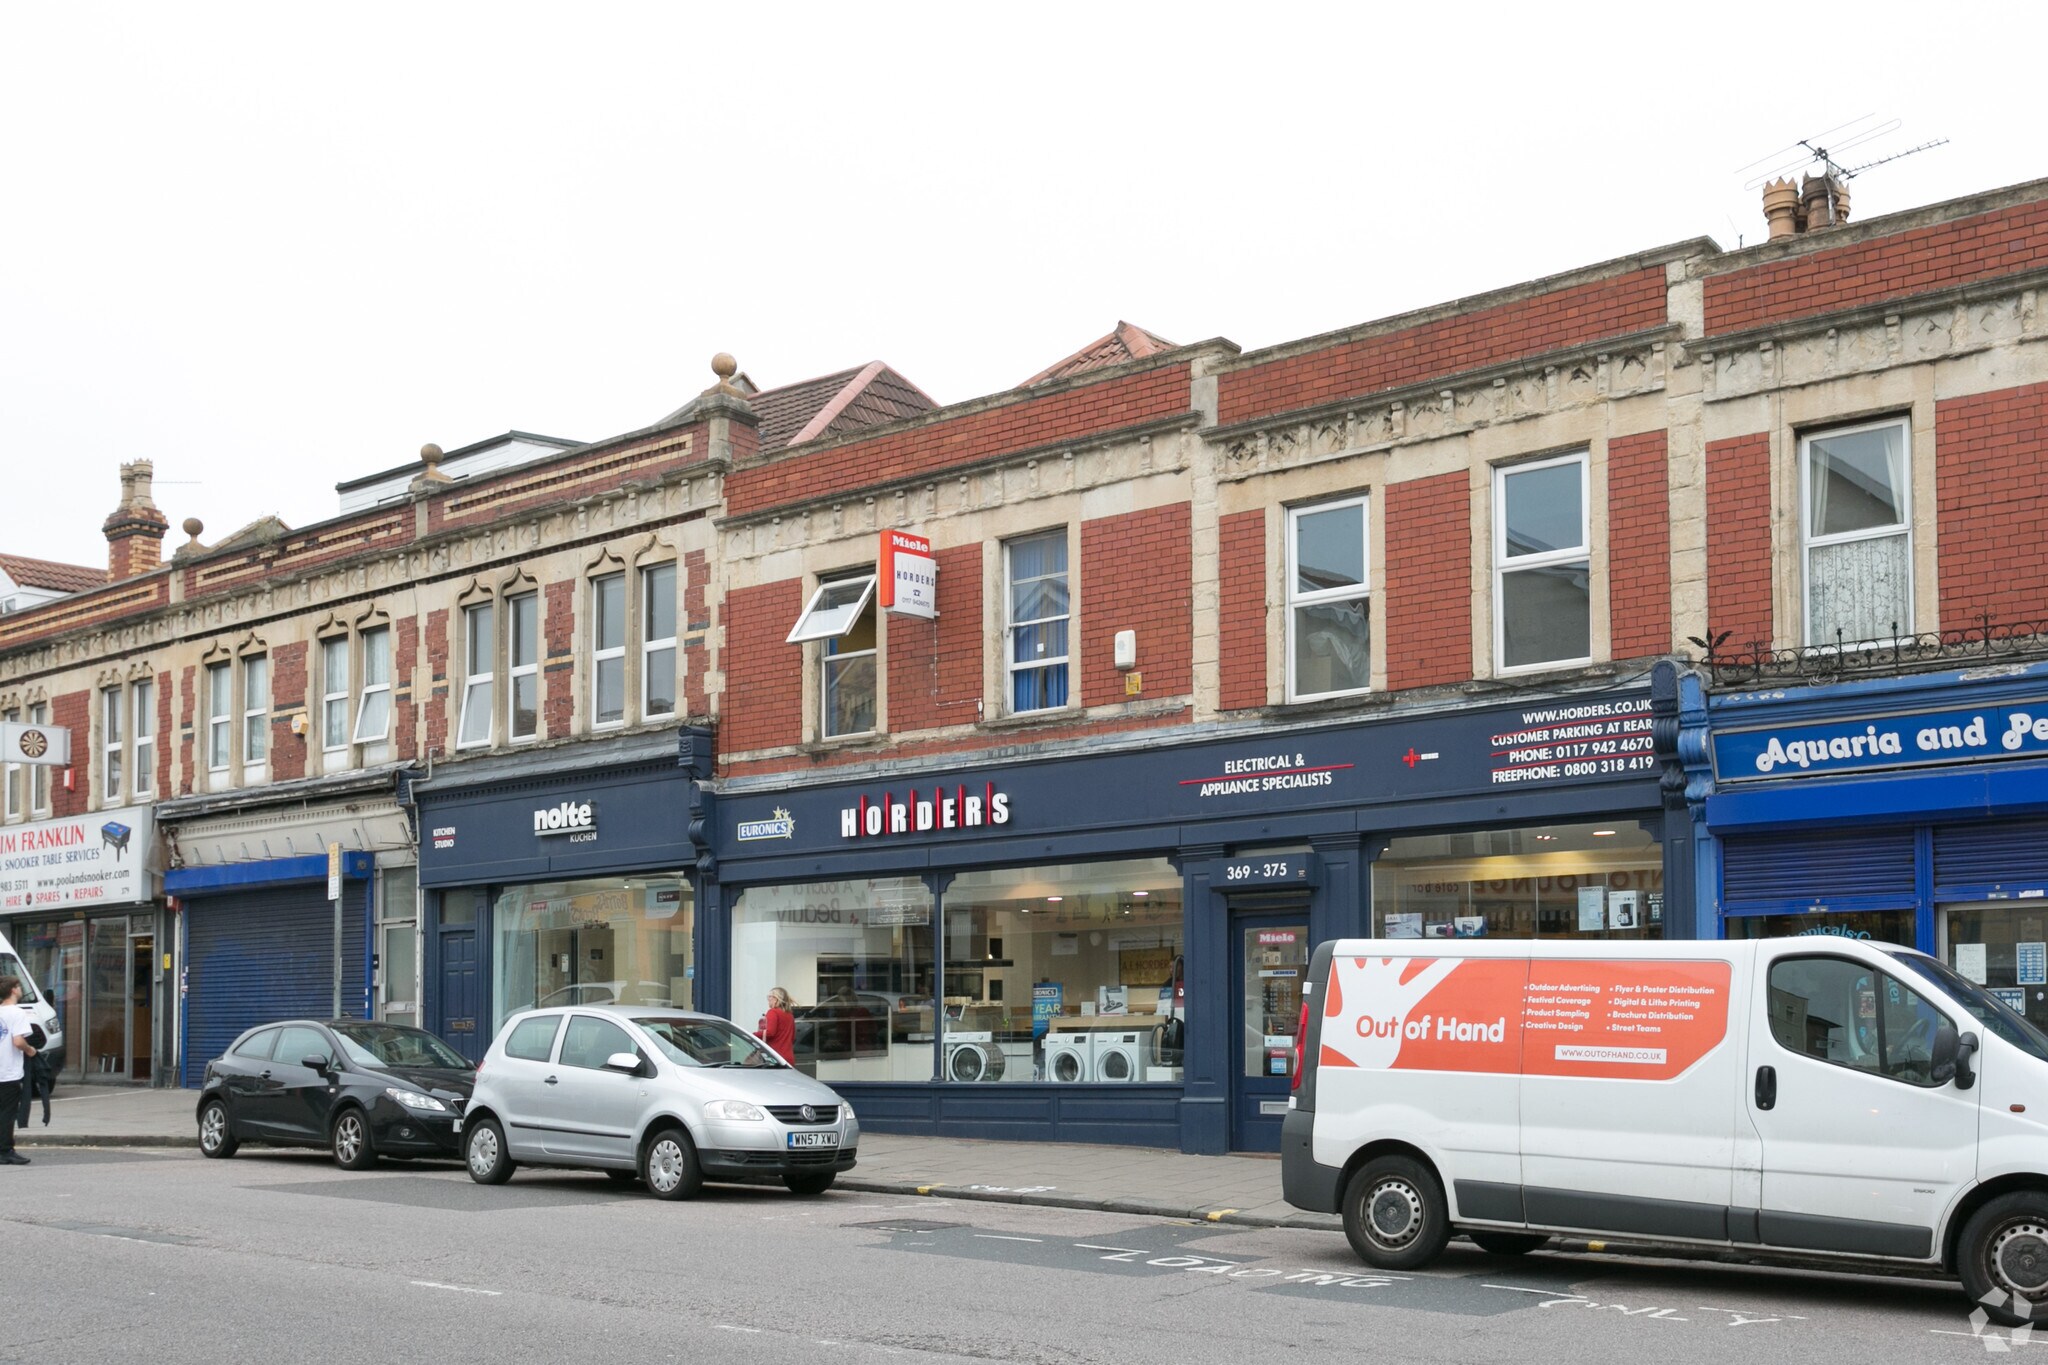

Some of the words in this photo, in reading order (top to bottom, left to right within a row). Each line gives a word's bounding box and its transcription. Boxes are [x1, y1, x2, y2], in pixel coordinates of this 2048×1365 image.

[892, 535, 928, 552] Miele
[896, 570, 934, 587] HORDERS
[1522, 699, 1653, 724] WWW.HORDERS.CO.UK
[1491, 730, 1550, 747] CUSTOMER
[1553, 724, 1603, 740] PARKING
[1606, 721, 1621, 734] AT
[1624, 718, 1653, 732] REAR
[1509, 748, 1552, 764] PHONE:
[1556, 744, 1588, 758] 0117
[1592, 740, 1616, 755] 942
[1620, 736, 1654, 752] 4670
[1755, 725, 1902, 773] Aquaria
[1916, 716, 1988, 752] and
[1224, 754, 1291, 774] ELECTRICAL
[1294, 753, 1305, 766] &
[1492, 766, 1560, 784] FREEPHONE:
[1564, 761, 1597, 776] 0800
[1600, 758, 1625, 773] 318
[1628, 756, 1654, 770] 419
[1200, 779, 1260, 797] APPLIANCE
[1262, 772, 1332, 791] SPECIALISTS
[534, 801, 592, 830] nolte
[841, 791, 1010, 838] HORDERS
[22, 824, 84, 852] FRANKLIN
[432, 826, 456, 837] KITCHEN
[570, 831, 598, 843] KÜCHEN
[740, 821, 788, 838] EURONICS
[434, 839, 454, 849] STUDIO
[5, 856, 40, 870] SNOOKER
[43, 852, 62, 866] TABLE
[66, 848, 100, 862] SERVICES
[15, 880, 28, 890] 5511
[37, 868, 130, 888] www.poolandsnooker.com
[1226, 865, 1251, 880] 369
[1263, 862, 1288, 877] 375
[6, 895, 22, 906] HIRE
[36, 891, 61, 904] SPARES
[74, 886, 104, 900] REPAIRS
[1259, 934, 1295, 943] Miele
[1559, 984, 1600, 994] Advertising
[1615, 985, 1634, 994] Flyer
[1668, 986, 1714, 994] Distribution
[1034, 1004, 1061, 1014] YEAR
[1528, 996, 1554, 1004] Festival
[1556, 997, 1592, 1006] Coverage
[1614, 998, 1640, 1007] Digital
[1669, 999, 1700, 1009] Printing
[1526, 1009, 1554, 1017] Product
[1556, 1010, 1590, 1019] Sampling
[1612, 1011, 1646, 1019] Brochure
[1648, 1012, 1694, 1020] Distribution
[1356, 1014, 1398, 1039] Out
[1404, 1016, 1431, 1040] of
[1436, 1018, 1505, 1043] Hand
[1526, 1022, 1556, 1030] Creative
[1558, 1022, 1584, 1032] Design
[1612, 1024, 1636, 1032] Street
[1636, 1024, 1662, 1032] Teams
[1561, 1048, 1662, 1060] WWW.OUTOFHAND.CO.UK
[794, 1134, 819, 1146] WN57
[821, 1134, 838, 1145] XWU
[1099, 1249, 1394, 1288] LOADING
